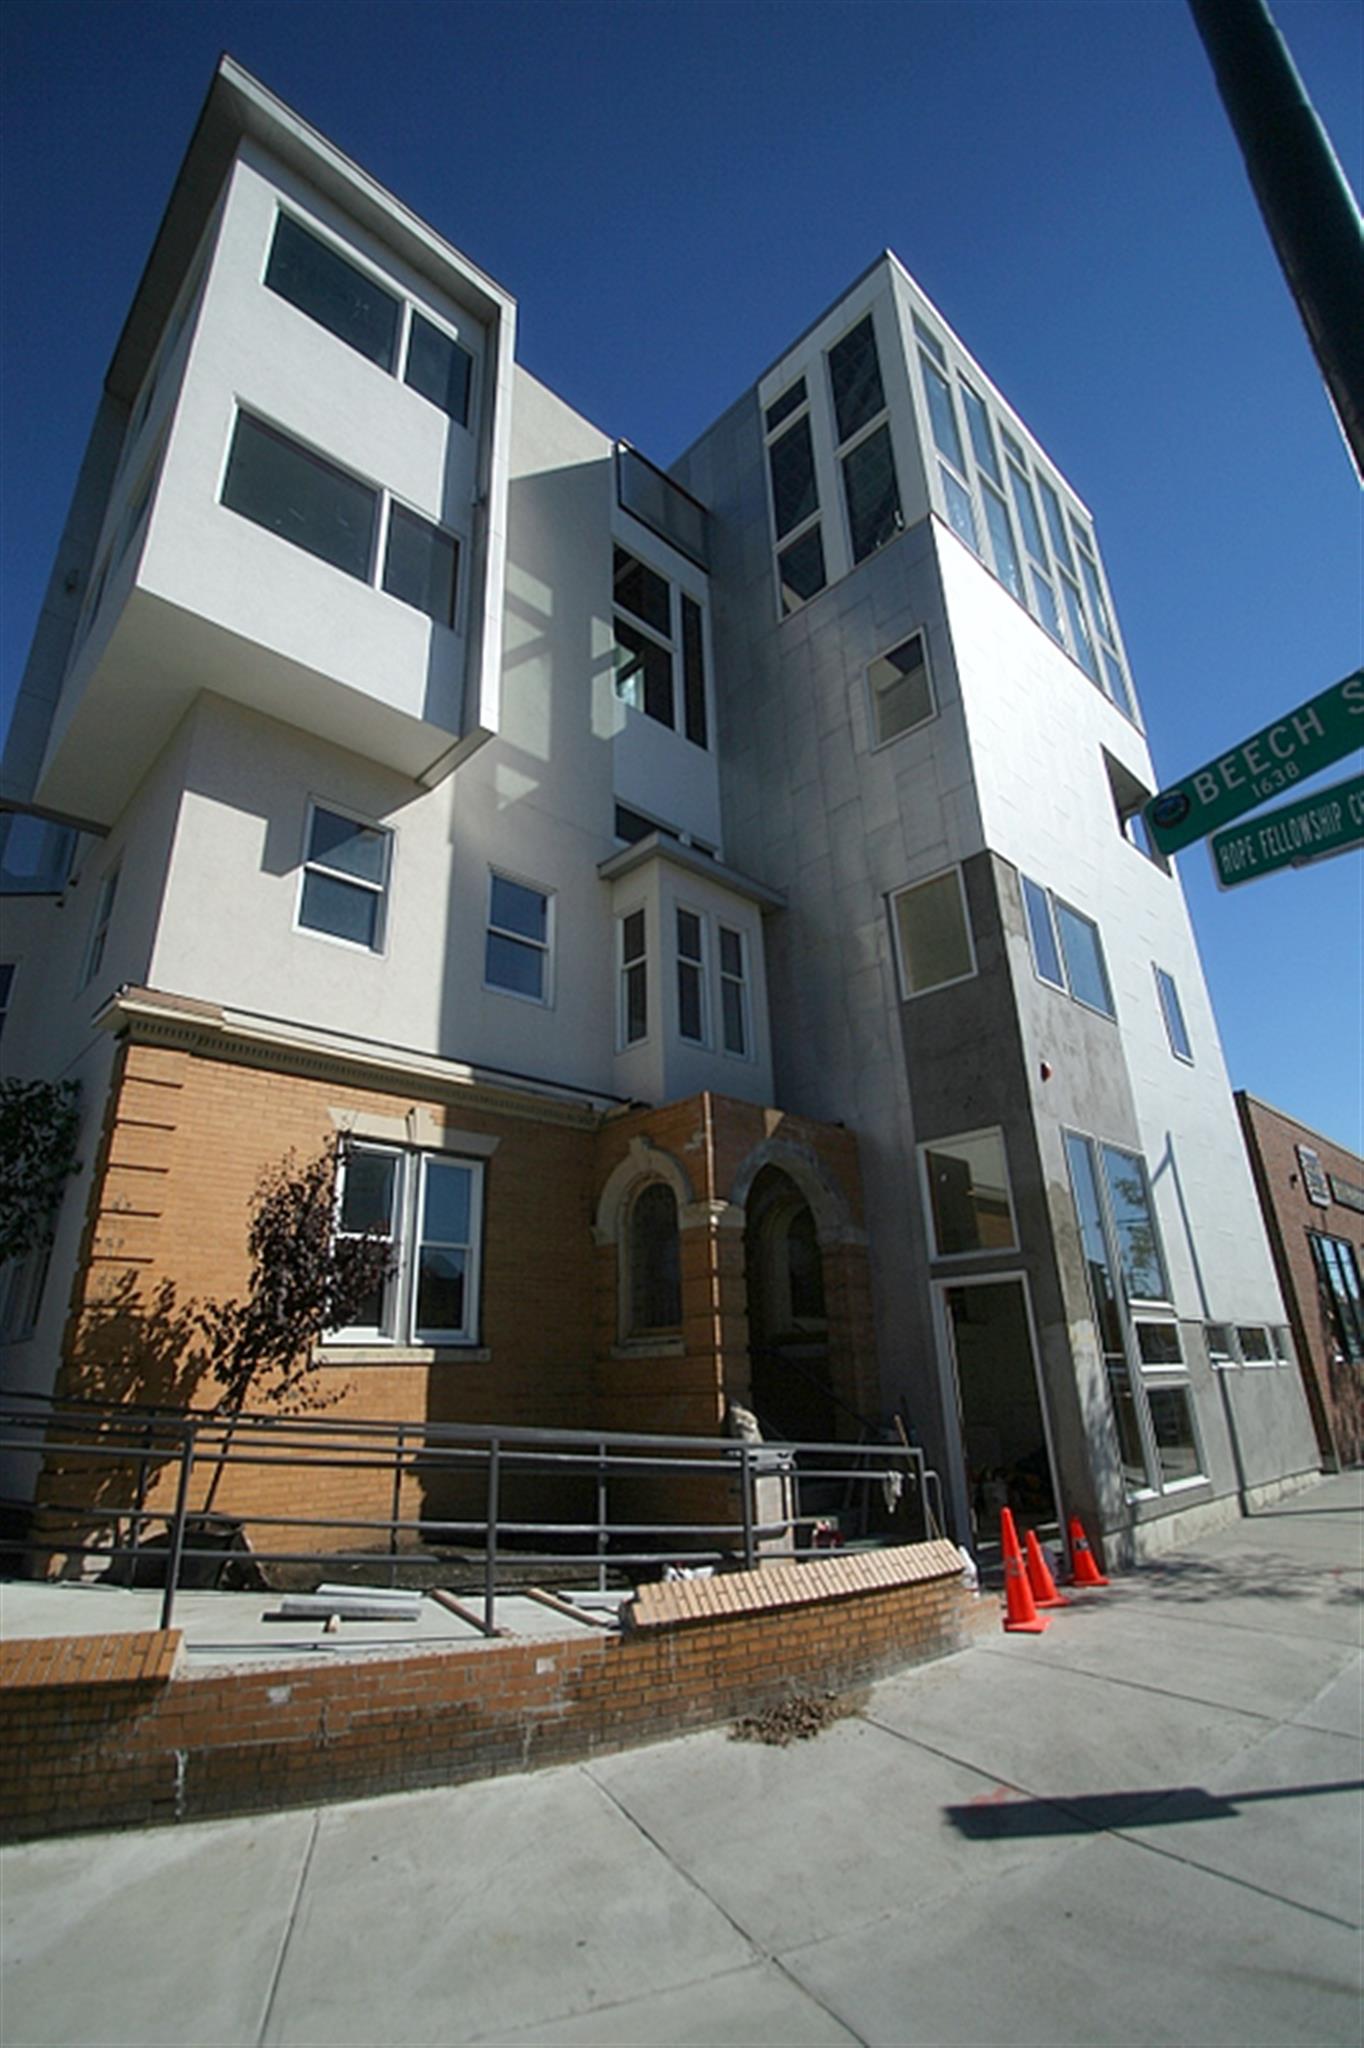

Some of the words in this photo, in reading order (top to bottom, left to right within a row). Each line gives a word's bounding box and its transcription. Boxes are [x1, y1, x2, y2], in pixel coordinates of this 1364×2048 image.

[1193, 707, 1325, 804] BEECH
[1252, 761, 1300, 798] 1638
[1219, 836, 1257, 874] HOPE
[1259, 802, 1342, 859] FELLOWSHIP
